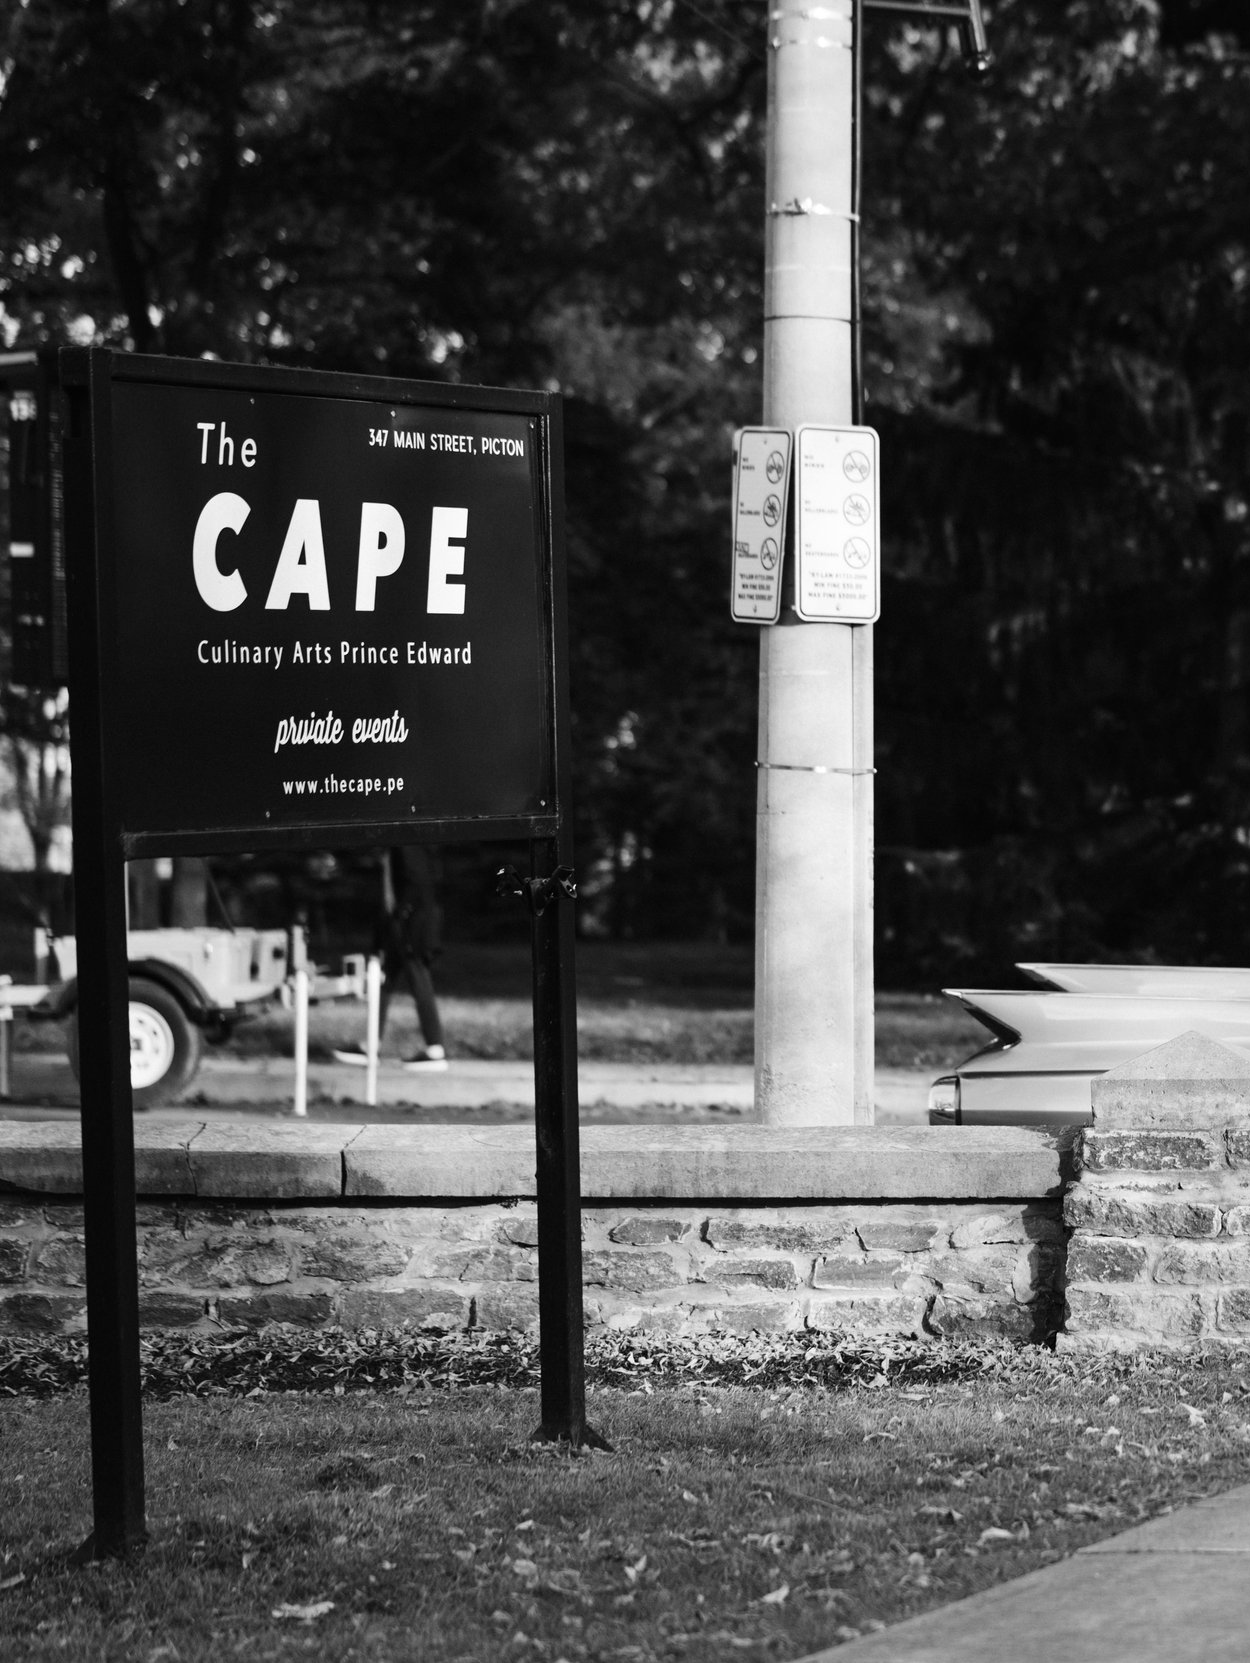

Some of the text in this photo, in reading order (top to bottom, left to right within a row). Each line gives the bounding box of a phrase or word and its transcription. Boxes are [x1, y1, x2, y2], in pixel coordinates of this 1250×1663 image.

[196, 421, 258, 468] The
[368, 428, 524, 458] 347 MAIN STREET, PICTON
[192, 491, 469, 615] CAPE
[197, 639, 472, 670] Culinary Arts Prince Edward
[274, 709, 409, 754] private events
[282, 773, 405, 797] www.thecape.pe
